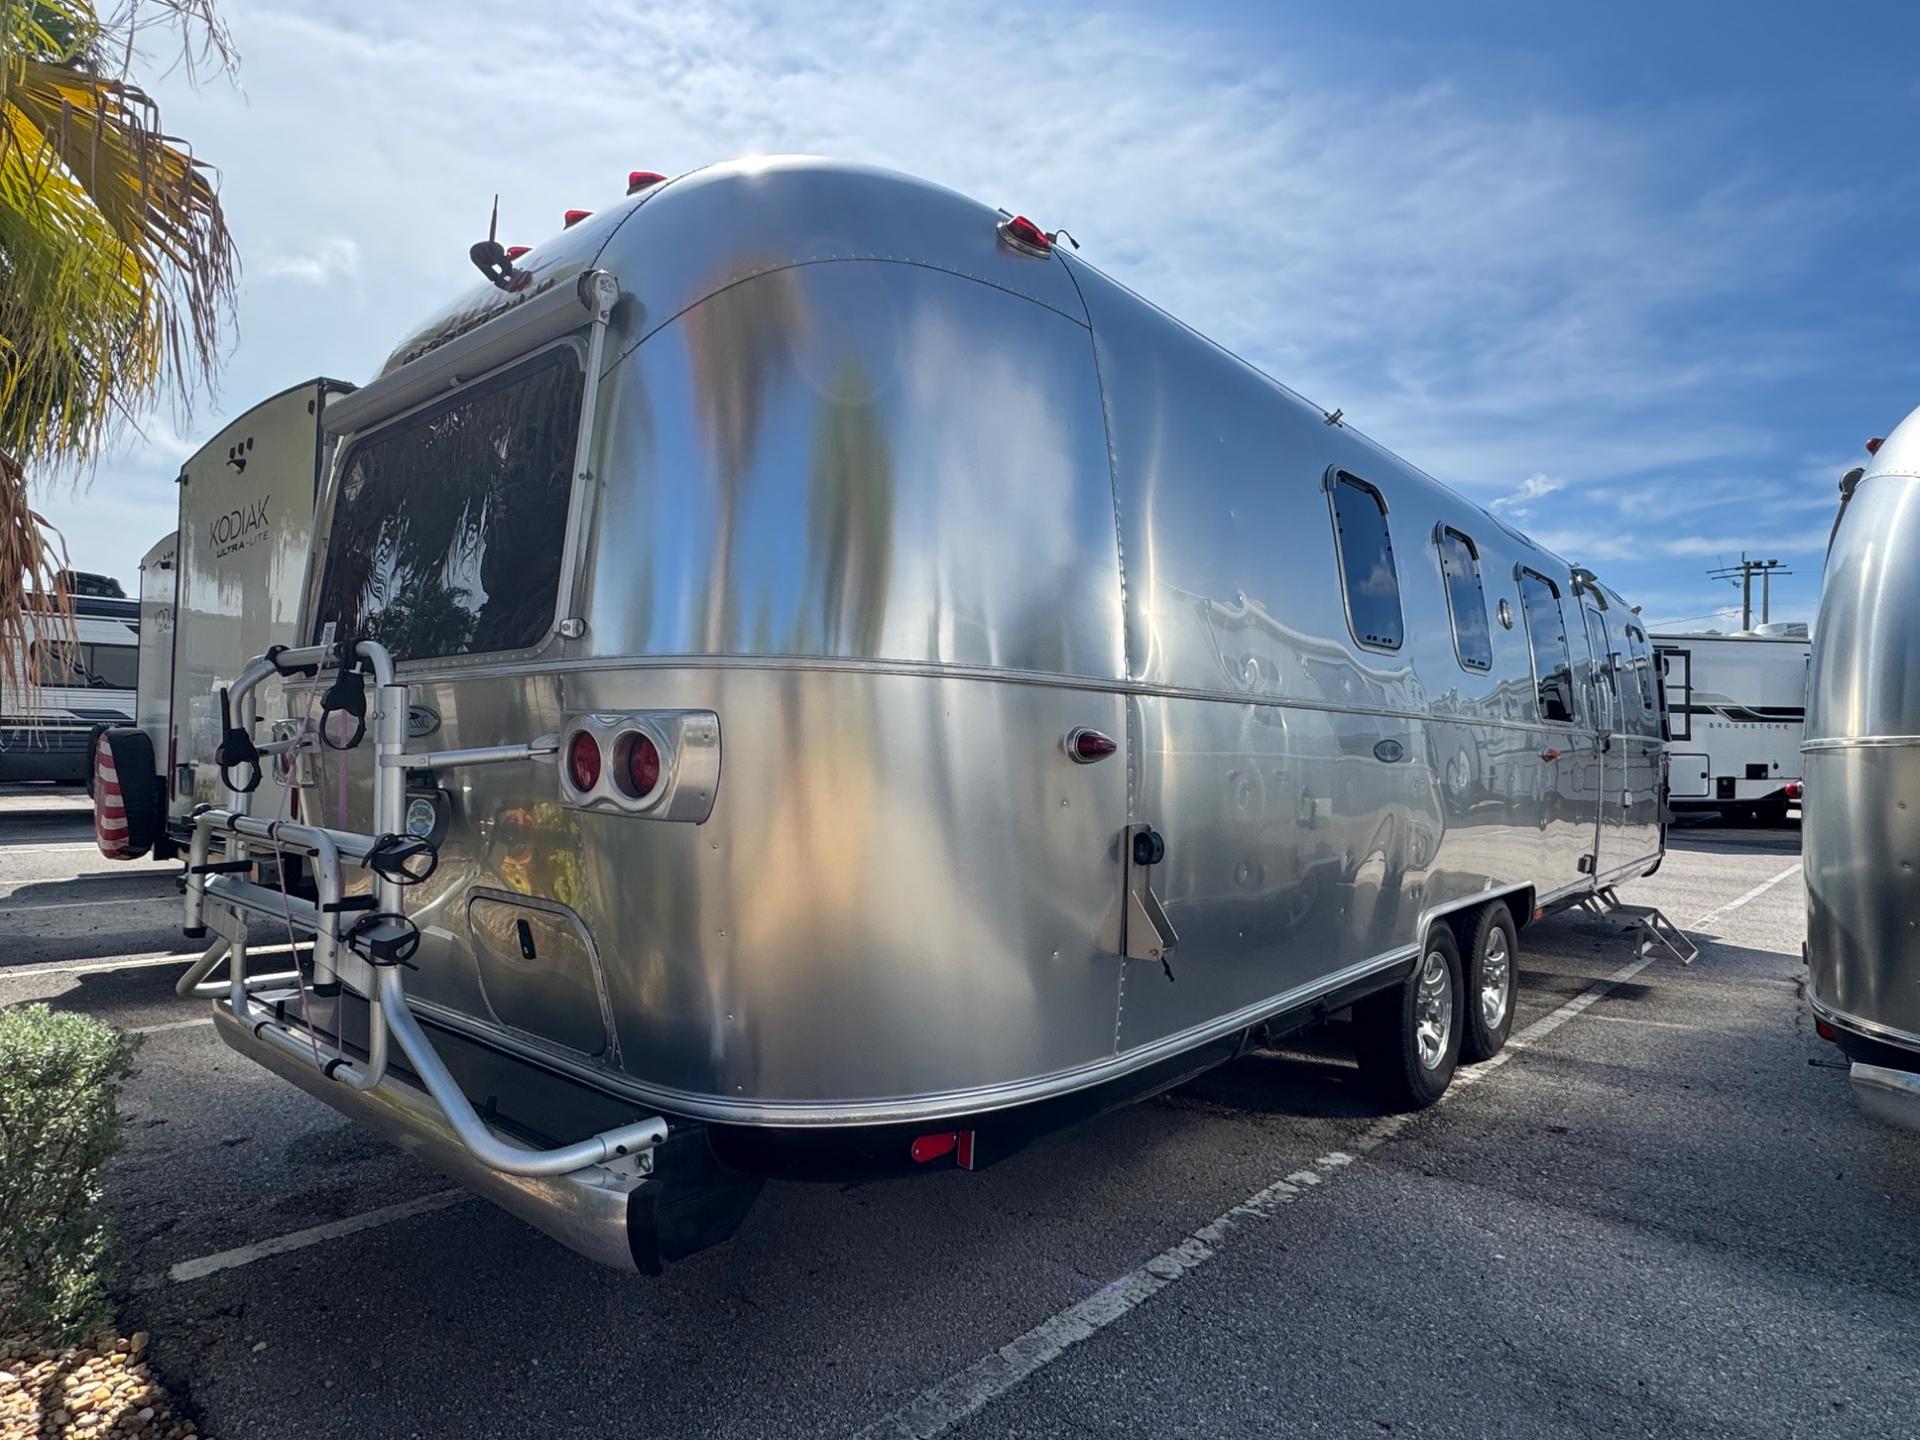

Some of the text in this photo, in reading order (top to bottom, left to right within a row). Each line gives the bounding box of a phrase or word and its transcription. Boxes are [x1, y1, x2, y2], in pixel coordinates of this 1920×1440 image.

[209, 495, 270, 549] KODIAK
[217, 530, 269, 558] ULTRA-LITE
[1708, 722, 1789, 730] BROOKSTONE
